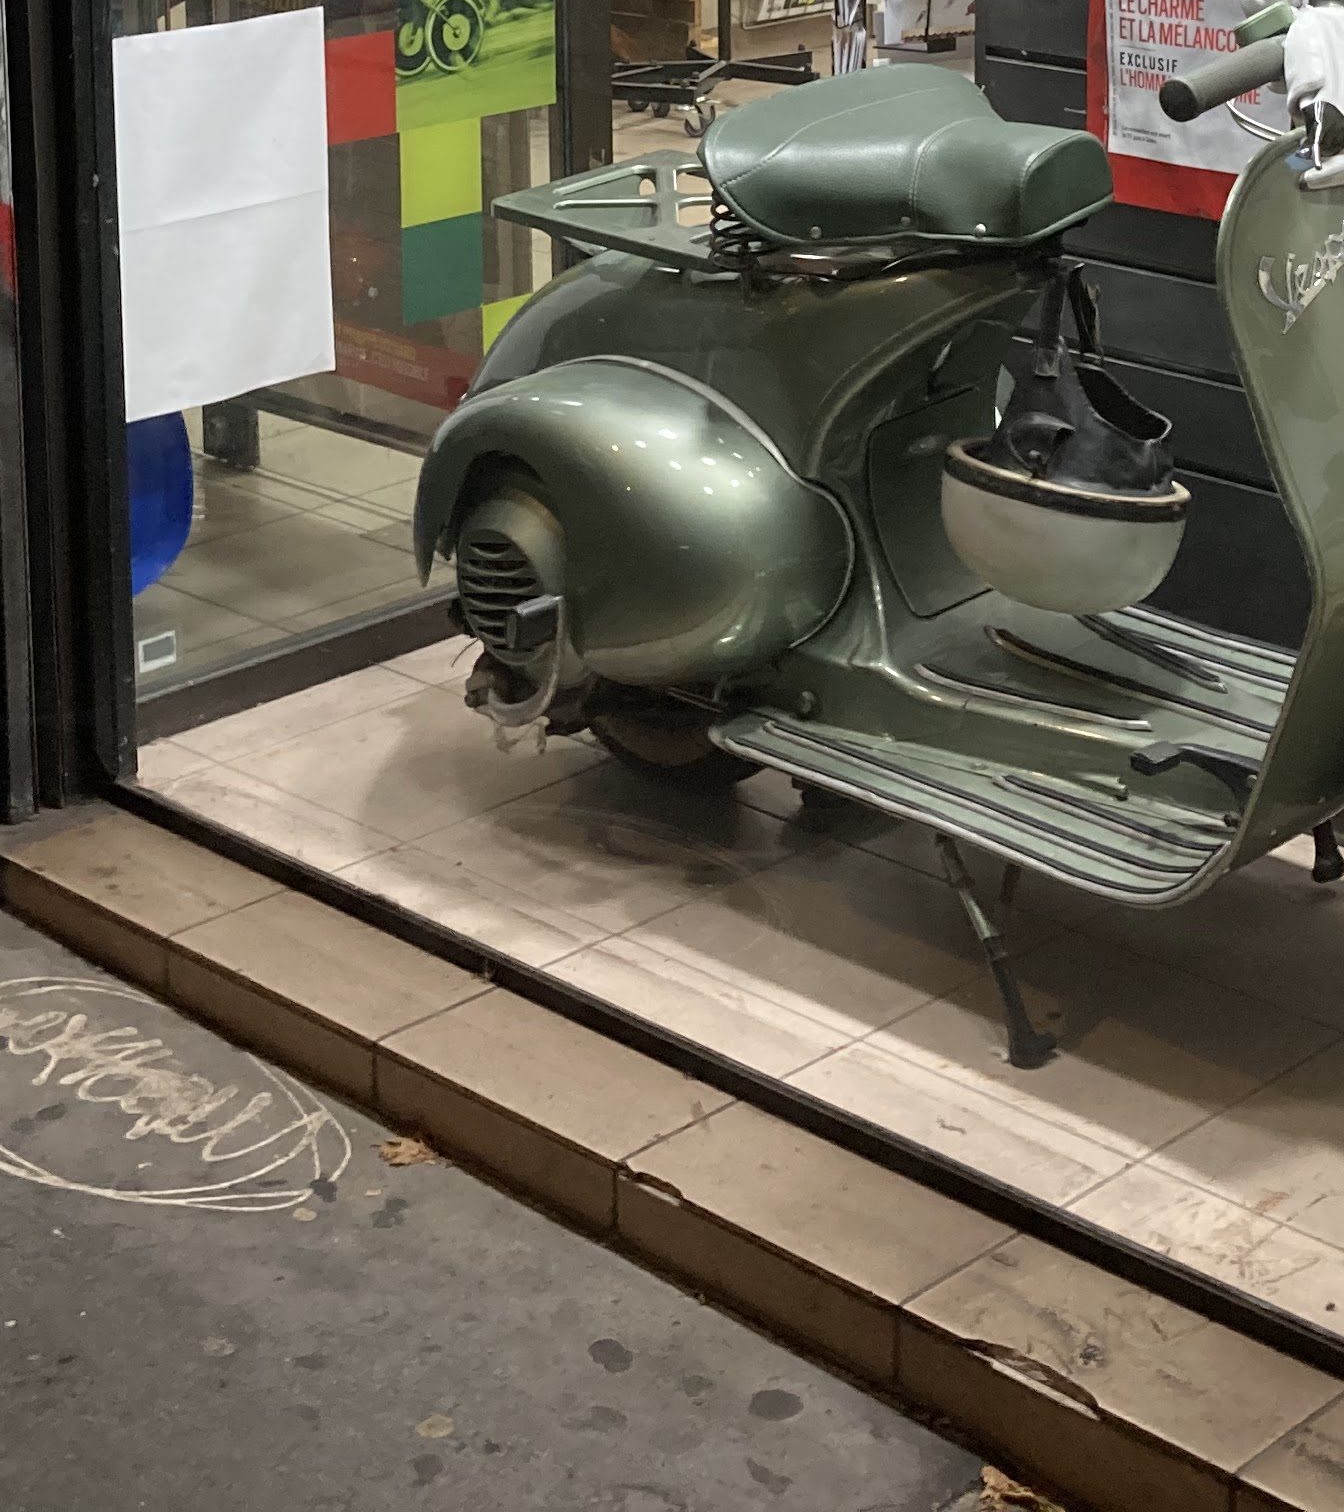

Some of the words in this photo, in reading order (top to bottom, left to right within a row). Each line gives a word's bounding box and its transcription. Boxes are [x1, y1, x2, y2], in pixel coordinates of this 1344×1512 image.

[1120, 17, 1138, 40] ET
[1139, 20, 1157, 44] LA
[1159, 20, 1237, 53] MÉLANCO
[1120, 51, 1178, 72] EXCLUSIF
